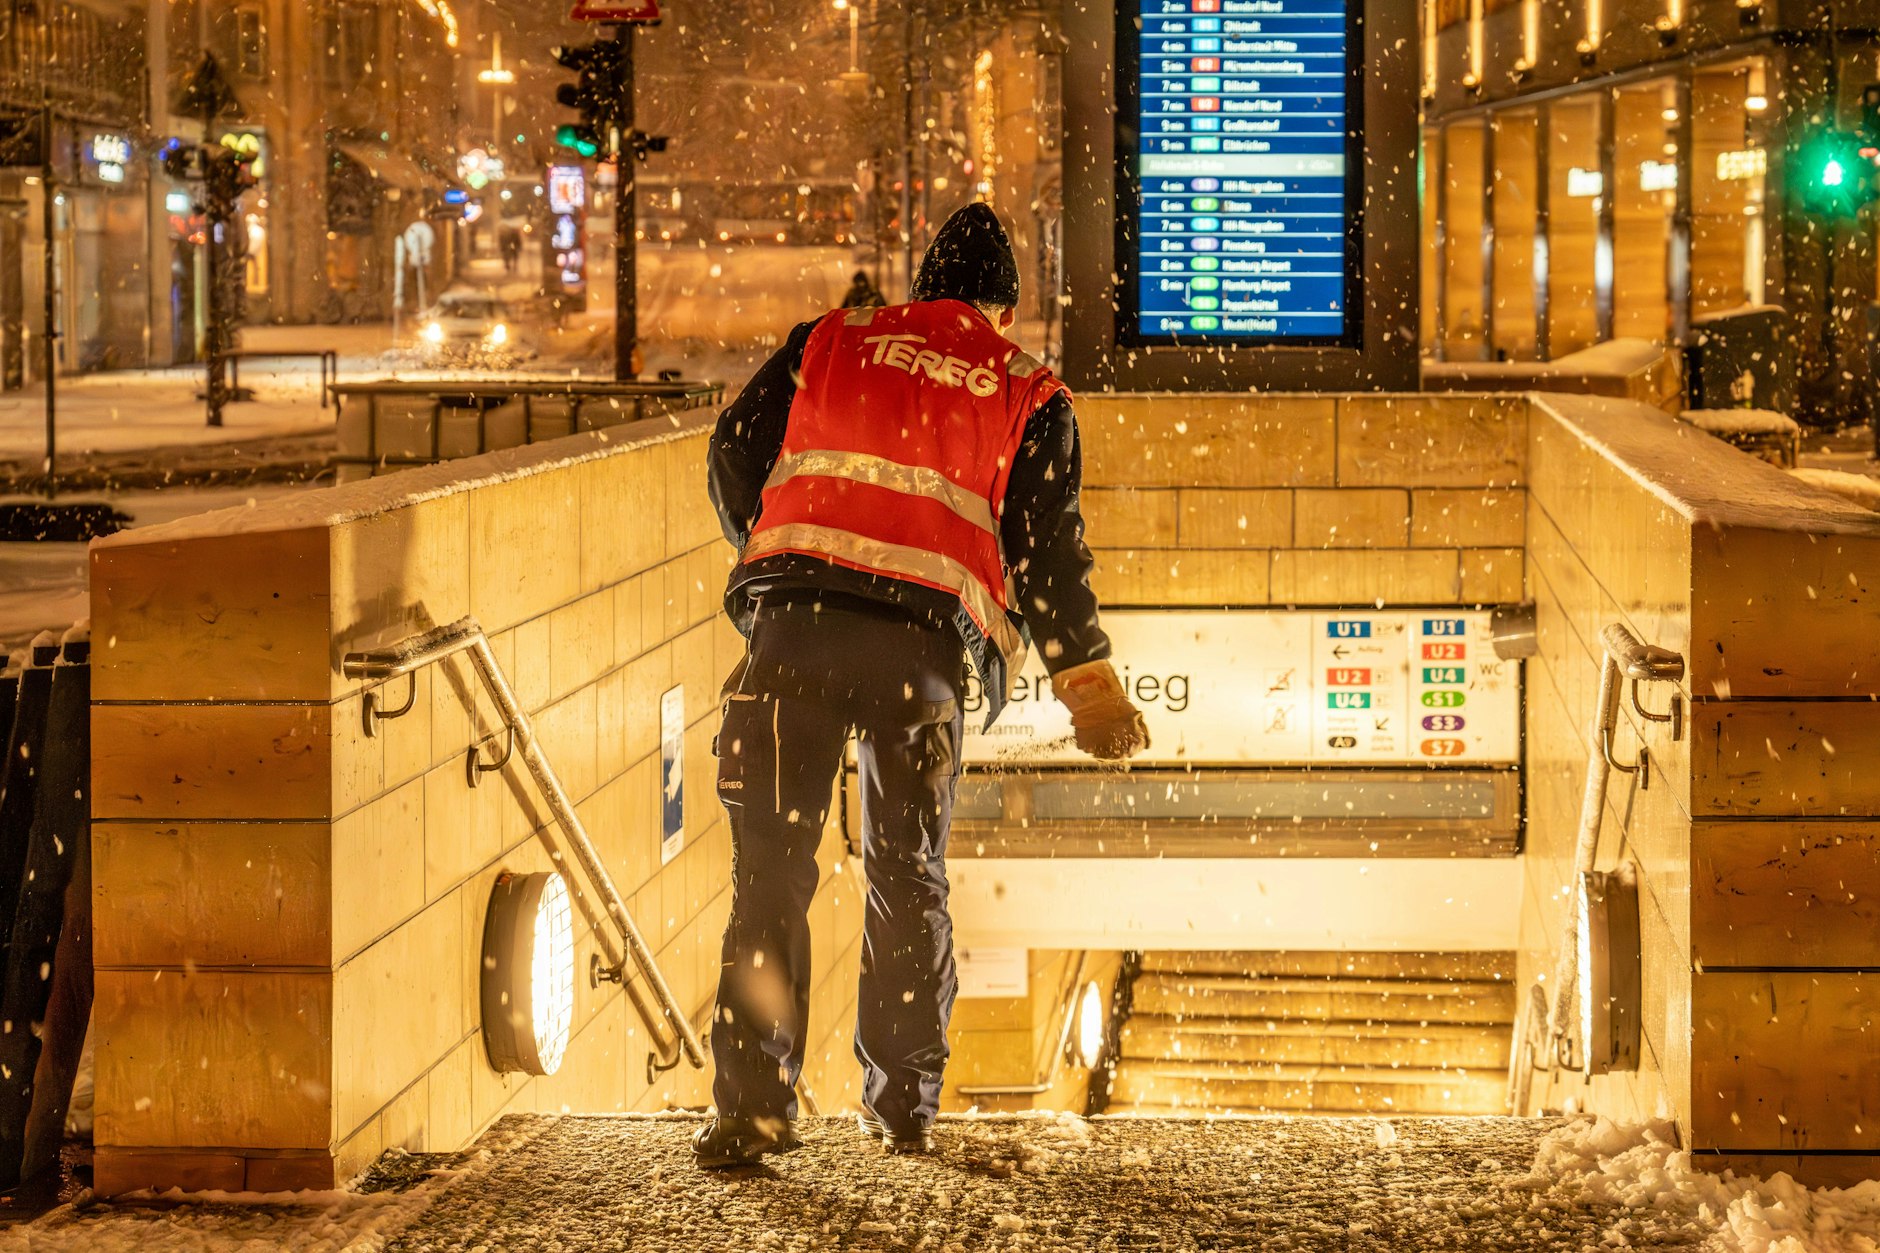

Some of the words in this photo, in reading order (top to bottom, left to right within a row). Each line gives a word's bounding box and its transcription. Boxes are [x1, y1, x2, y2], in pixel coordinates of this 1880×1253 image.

[864, 334, 999, 397] TEREG
[1337, 622, 1361, 636] U1
[1431, 620, 1455, 635] U1
[1431, 645, 1457, 659] U2
[1430, 668, 1457, 682] U4
[1479, 663, 1504, 676] WC
[1336, 670, 1364, 684] U2
[1336, 692, 1365, 708] U4
[1432, 692, 1454, 706] S1
[1431, 716, 1455, 730] S3
[1431, 740, 1456, 755] S7
